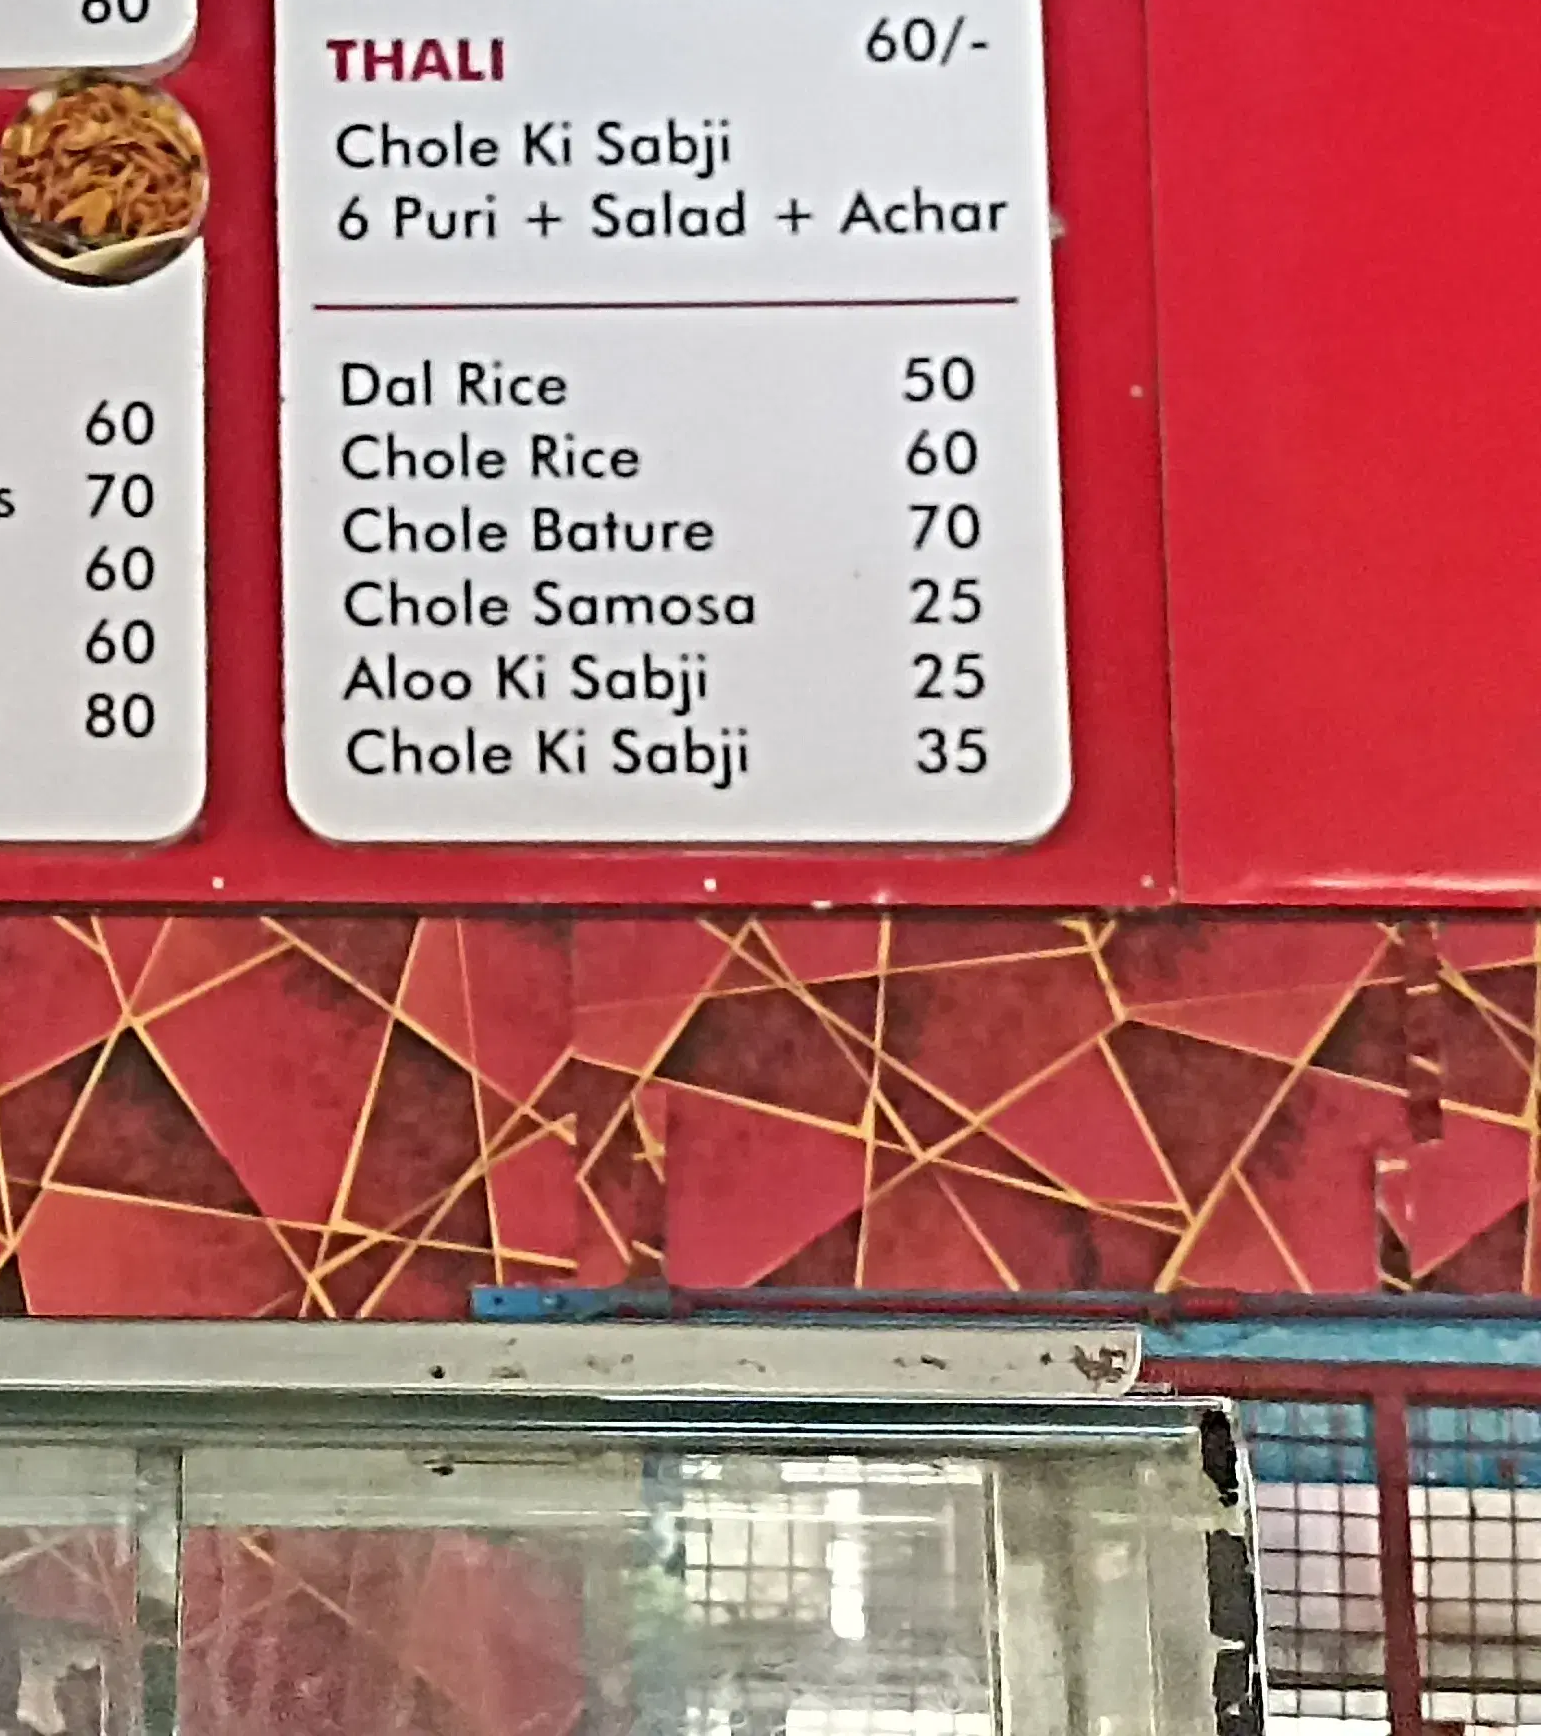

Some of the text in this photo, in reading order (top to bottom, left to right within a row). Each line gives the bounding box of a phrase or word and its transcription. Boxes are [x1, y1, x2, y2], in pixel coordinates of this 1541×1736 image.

[325, 15, 988, 83] THALI 60/-
[336, 118, 730, 180] Chole Ki Sabji
[338, 186, 1008, 241] 6 Puri + Salad + Achar
[341, 356, 975, 407] Dal Rice 50
[85, 399, 154, 446] 60
[341, 429, 978, 481] Chole Rice 60
[86, 473, 154, 519] 70
[343, 503, 980, 554] Chole Bature 70
[85, 545, 155, 592] 60
[344, 578, 982, 627] Chole Samosa 25
[86, 618, 155, 665] 60
[343, 652, 986, 717] Aloo Ki Sabji 25
[85, 692, 155, 739] 80
[346, 726, 987, 790] Chole Ki Sabji 35
